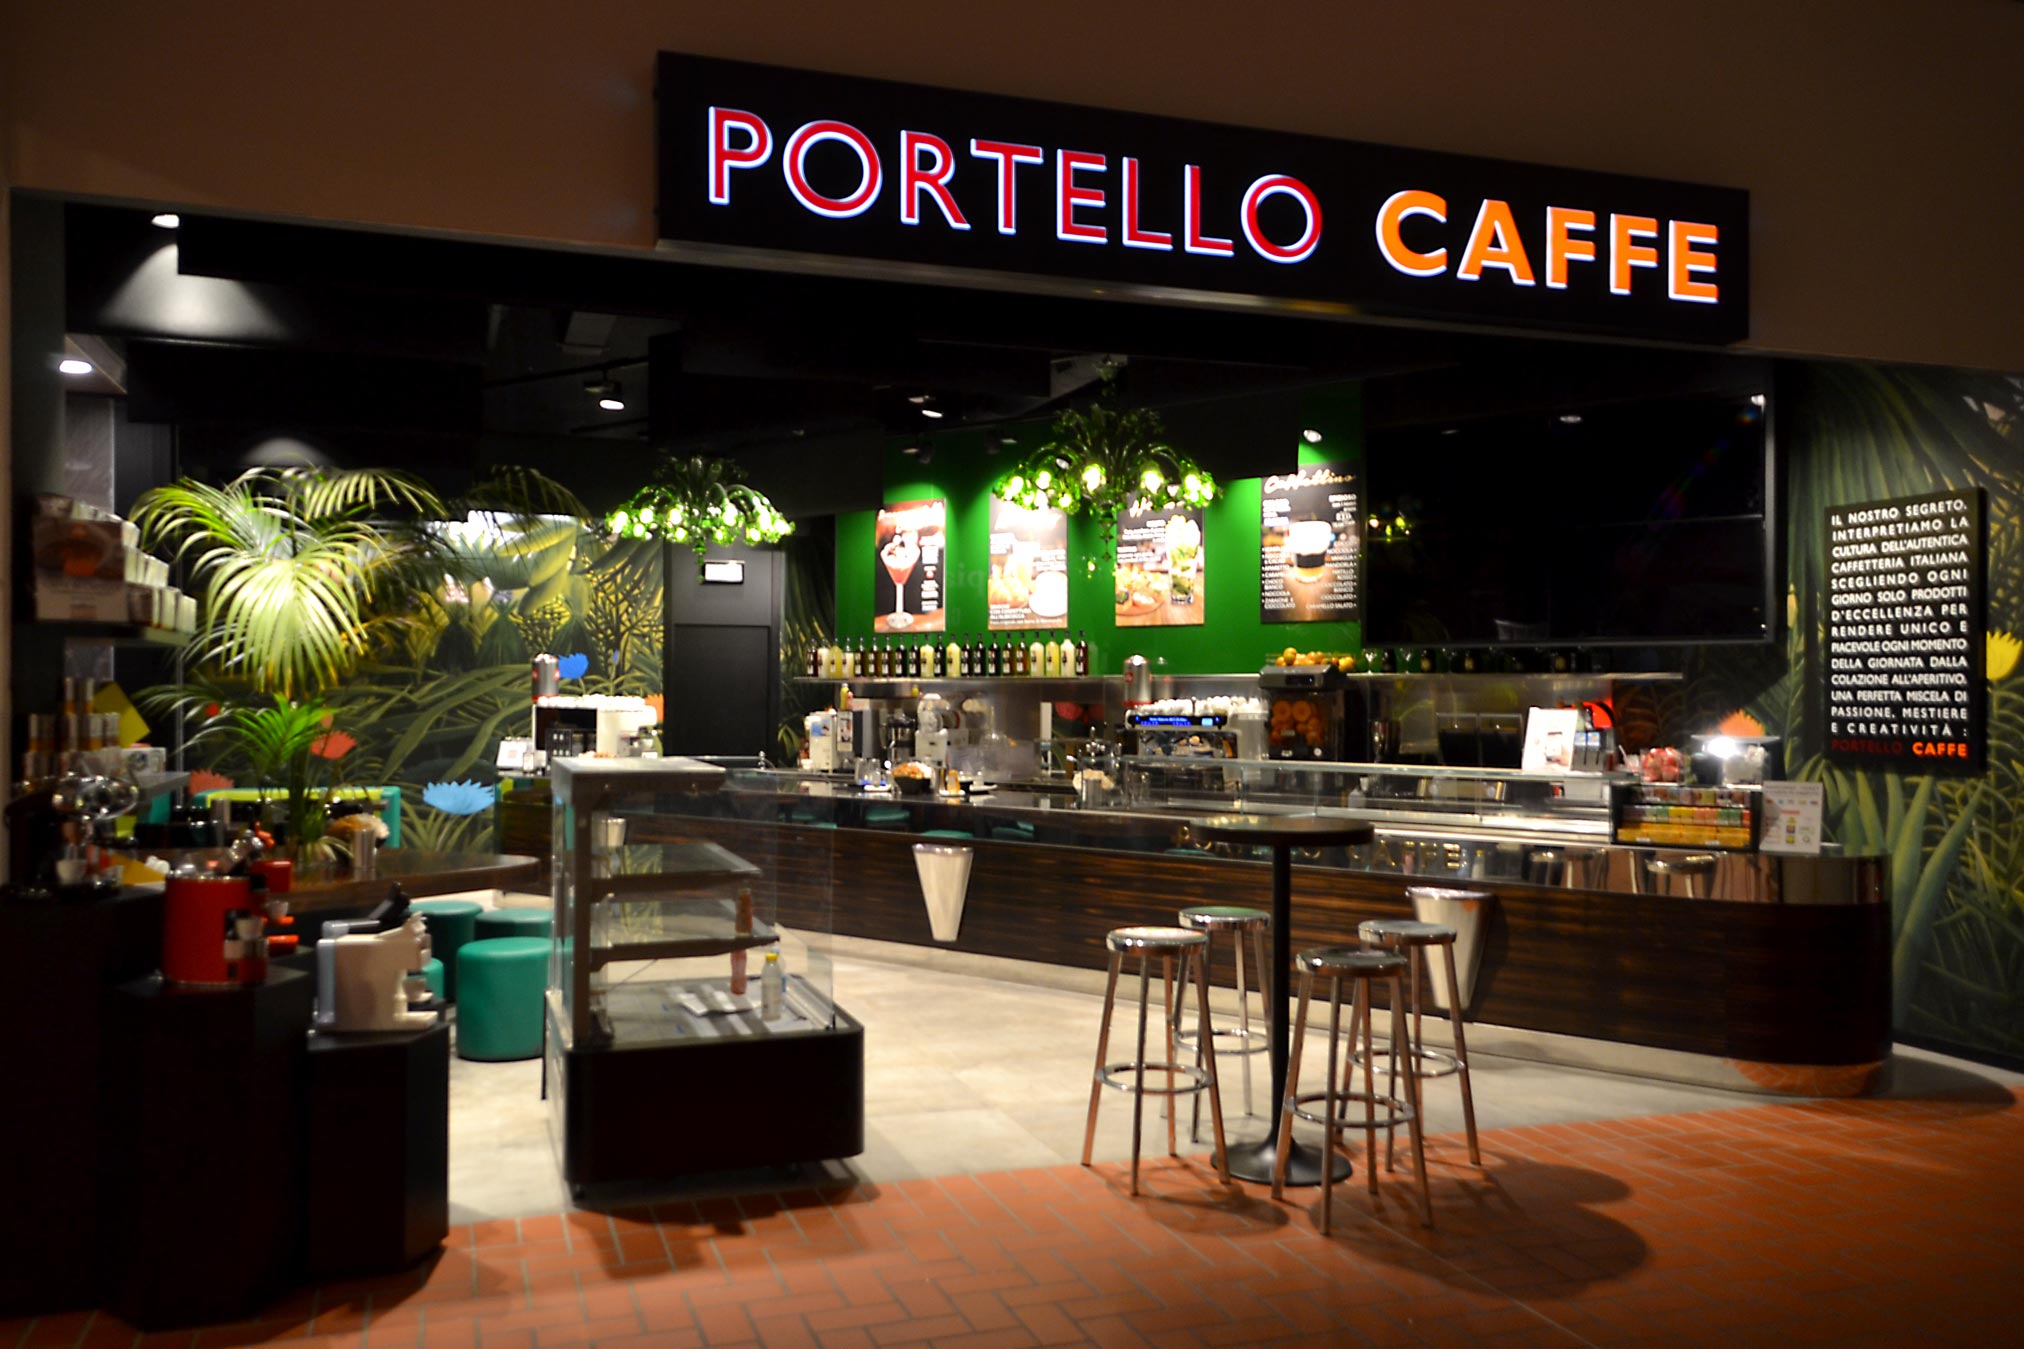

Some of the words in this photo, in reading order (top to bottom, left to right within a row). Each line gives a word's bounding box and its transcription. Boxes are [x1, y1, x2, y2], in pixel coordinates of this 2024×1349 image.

[707, 105, 1323, 265] PORTELLO
[1375, 189, 1719, 303] CAFFE
[1831, 515, 1842, 525] IL
[1849, 507, 1899, 523] NOSTRO
[1833, 519, 1942, 541] INTERPRETIAMO
[1951, 517, 1968, 528] LA
[1833, 543, 1877, 557] CULTURA
[1881, 534, 1968, 552] DELL'AUTENTICA
[1831, 557, 1904, 572] CAFFETTERIA
[1910, 552, 1968, 566] ITALIANA
[1831, 572, 1919, 589] SCEGLIENDO
[1927, 569, 1967, 581] OGNI
[1831, 593, 1872, 605] GIORNO
[1877, 590, 1906, 601] SOLO
[1911, 586, 1967, 600] PRODOTTI
[1831, 606, 1933, 621] D'ECCELLENZA
[1941, 604, 1968, 616] PER
[1831, 624, 1892, 636] RENDERE
[1901, 622, 1951, 634] UNICO
[1960, 621, 1968, 632] E
[1831, 641, 1880, 652] PIACEVOLE
[1882, 640, 1909, 651] OGNI
[1911, 639, 1967, 650] MOMENTO
[1831, 658, 1862, 669] DELLA
[1868, 657, 1924, 668] GIORNATA
[1930, 656, 1967, 667] DALLA
[1831, 674, 1888, 685] COLAZIONE
[1831, 691, 1853, 701] UNA
[1857, 690, 1901, 701] PERFETTA
[1907, 691, 1949, 701] MISCELA
[1955, 691, 1967, 702] DI
[1902, 708, 1967, 719] MESTIERE
[1831, 723, 1838, 733] E
[1847, 723, 1952, 736] CREATIVITÀ
[1831, 740, 1902, 753] PORTELLO
[1913, 742, 1967, 757] CAFFE
